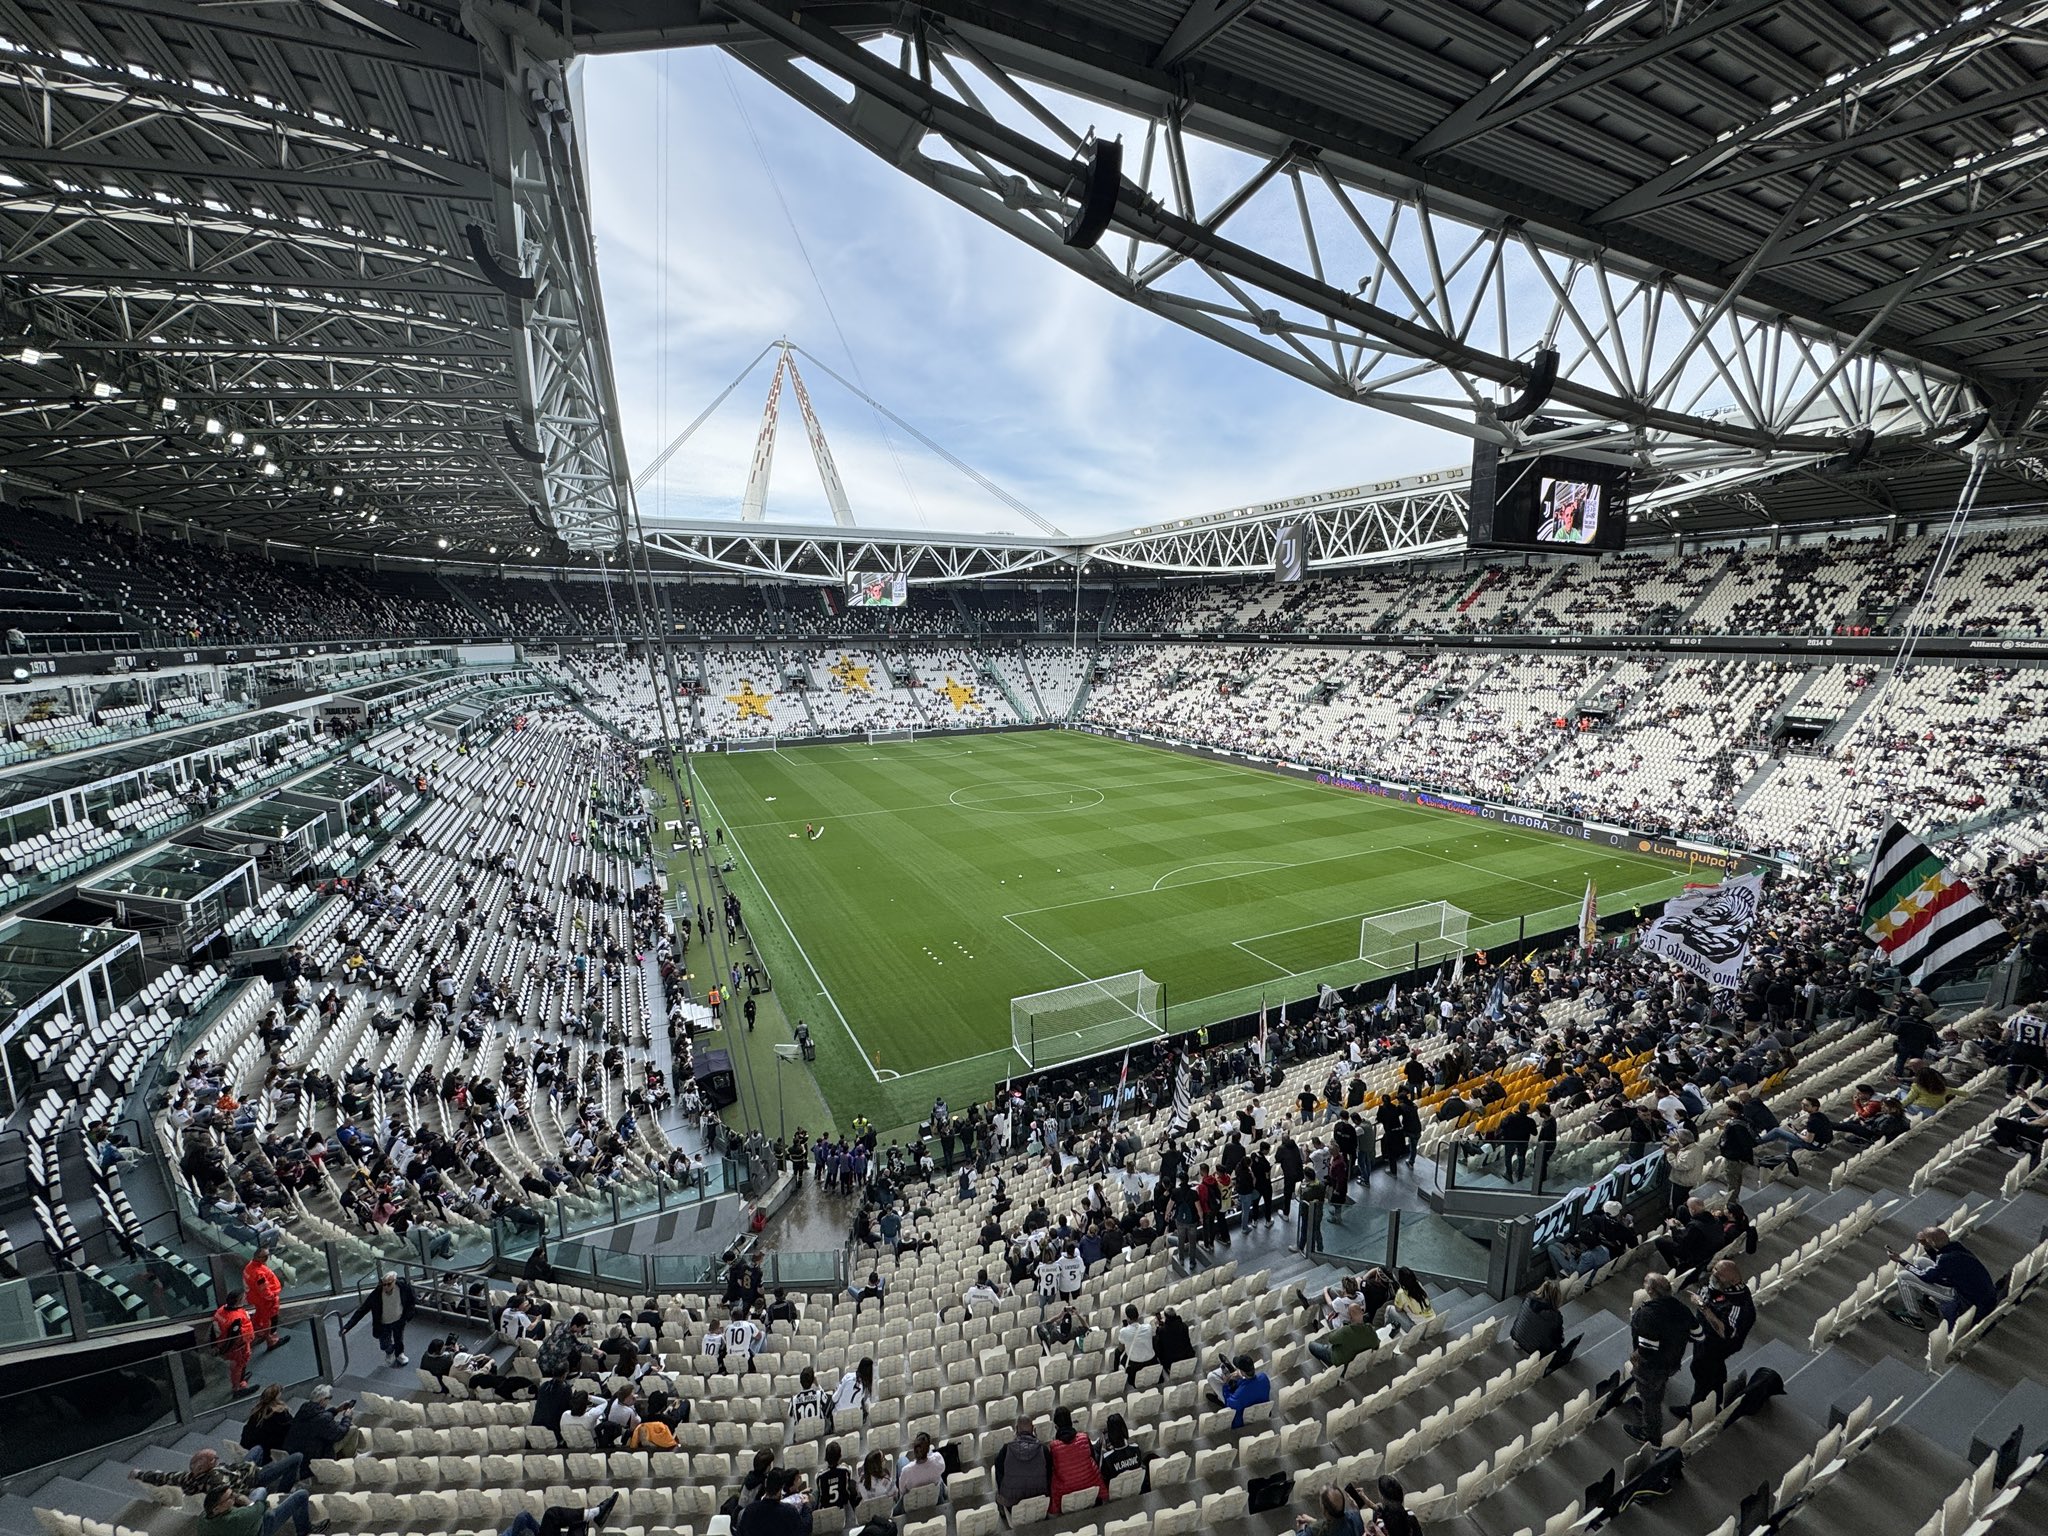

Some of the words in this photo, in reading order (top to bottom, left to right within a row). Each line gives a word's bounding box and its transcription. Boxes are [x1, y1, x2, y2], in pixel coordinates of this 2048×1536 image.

[1969, 640, 2001, 649] Allianz
[29, 661, 48, 674] 1978
[324, 706, 361, 715] JUVENTUS
[1653, 843, 1688, 859] Lunar
[2024, 1025, 2035, 1038] 9
[1045, 1273, 1054, 1287] 9
[1069, 1270, 1077, 1281] 5
[730, 1327, 745, 1346] 10
[705, 1343, 716, 1356] 10
[850, 1382, 862, 1404] 7
[797, 1402, 816, 1419] 10
[828, 1483, 840, 1503] 5
